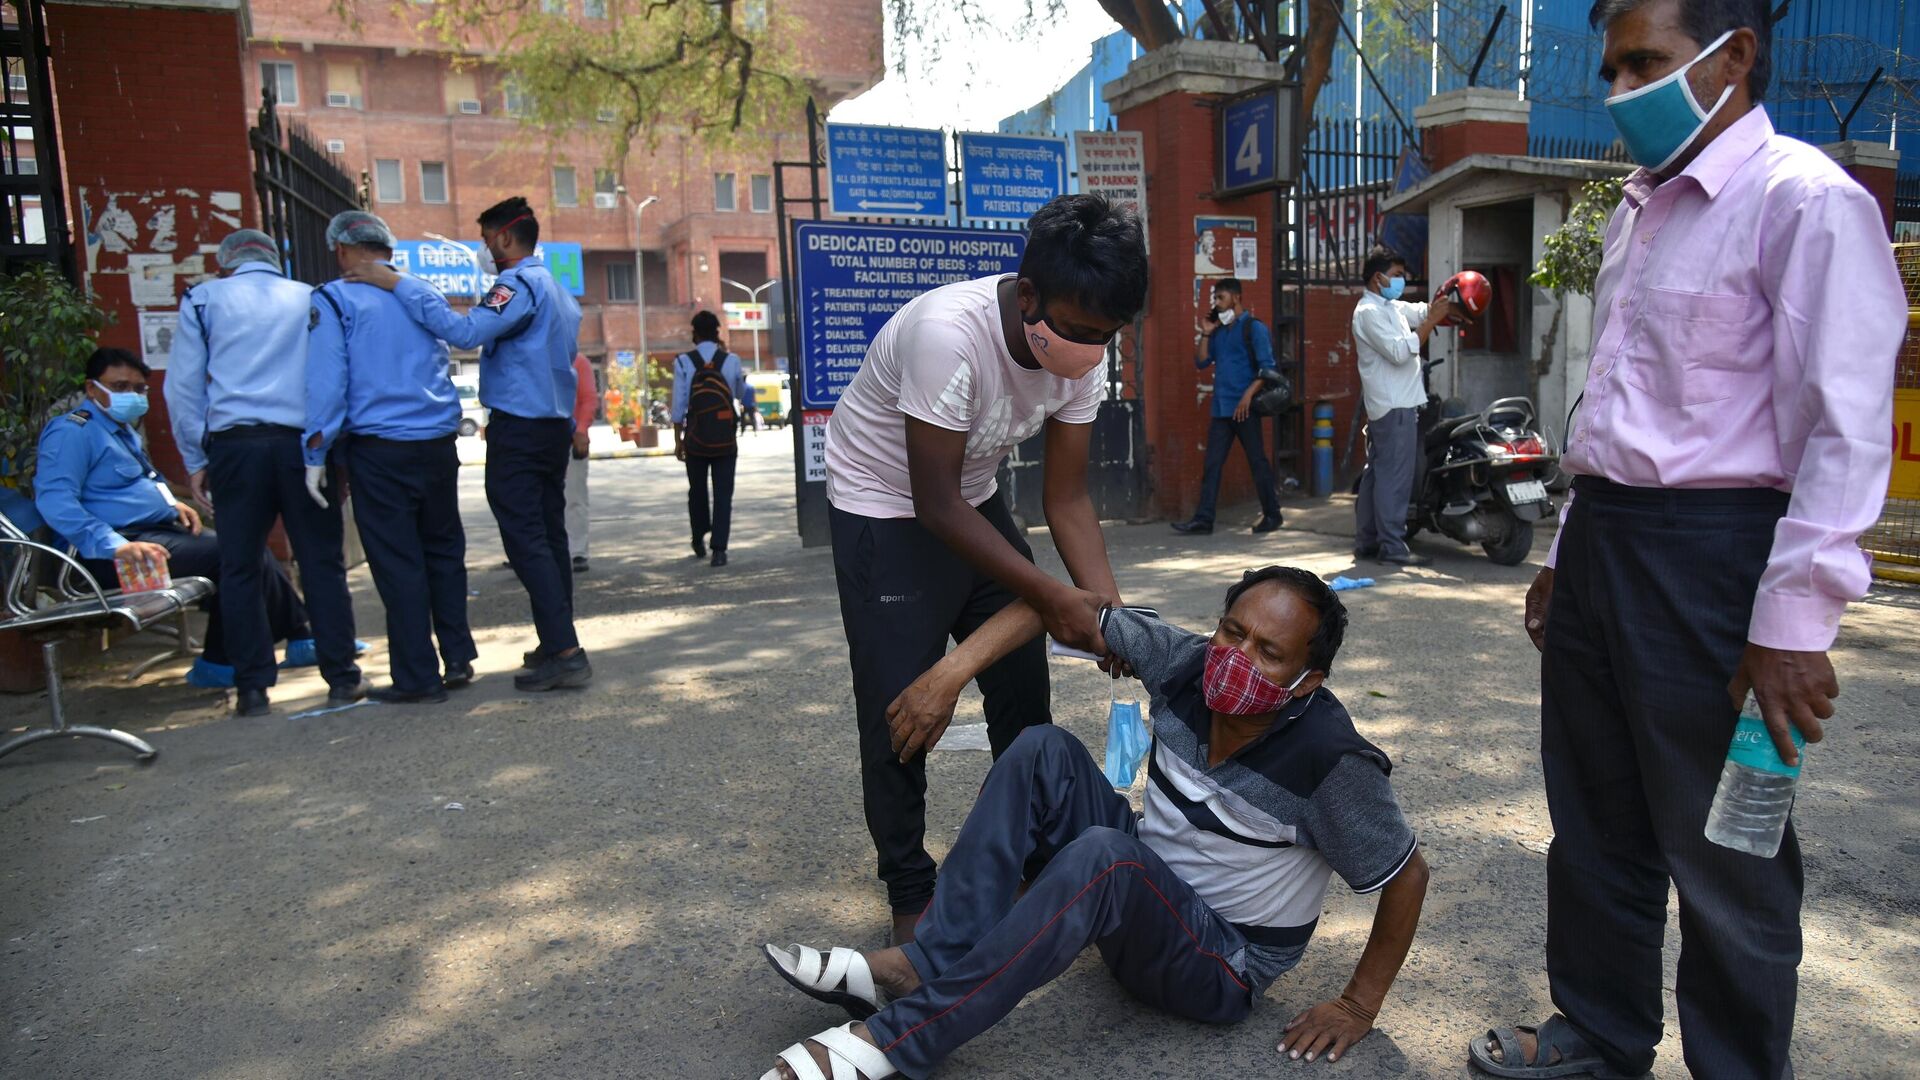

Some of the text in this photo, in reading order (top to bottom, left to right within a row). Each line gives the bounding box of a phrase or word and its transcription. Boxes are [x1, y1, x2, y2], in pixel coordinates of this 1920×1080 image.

[967, 142, 1054, 163] केवल आपातकालीन
[1235, 123, 1262, 176] 4
[1011, 163, 1023, 180] के
[1024, 165, 1044, 183] लिए
[836, 174, 850, 183] ALL
[903, 177, 928, 187] PLEASE
[1087, 175, 1138, 186] NO PARKING
[916, 190, 938, 200] BLOCK
[971, 184, 1054, 199] WAY TO EMERGENCY
[983, 200, 1044, 214] PATIENTS ONLY
[808, 234, 1019, 257] DEDICATED COVID HOSPITAL
[830, 255, 867, 268] TOTAL
[869, 256, 917, 270] NUMBER
[920, 257, 935, 270] OF
[937, 258, 966, 271] BEDS
[977, 260, 1000, 271] 2010
[551, 252, 579, 289] H
[854, 271, 970, 285] FACILITIES INCLUDES
[824, 288, 875, 298] TREATMENT
[877, 289, 890, 299] OF
[824, 302, 866, 312] PATIENTS
[824, 316, 865, 326] ICU/HDU.
[825, 330, 867, 340] DIALYSIS.
[826, 344, 868, 354] DELIVERY
[826, 357, 862, 368] PLASMA
